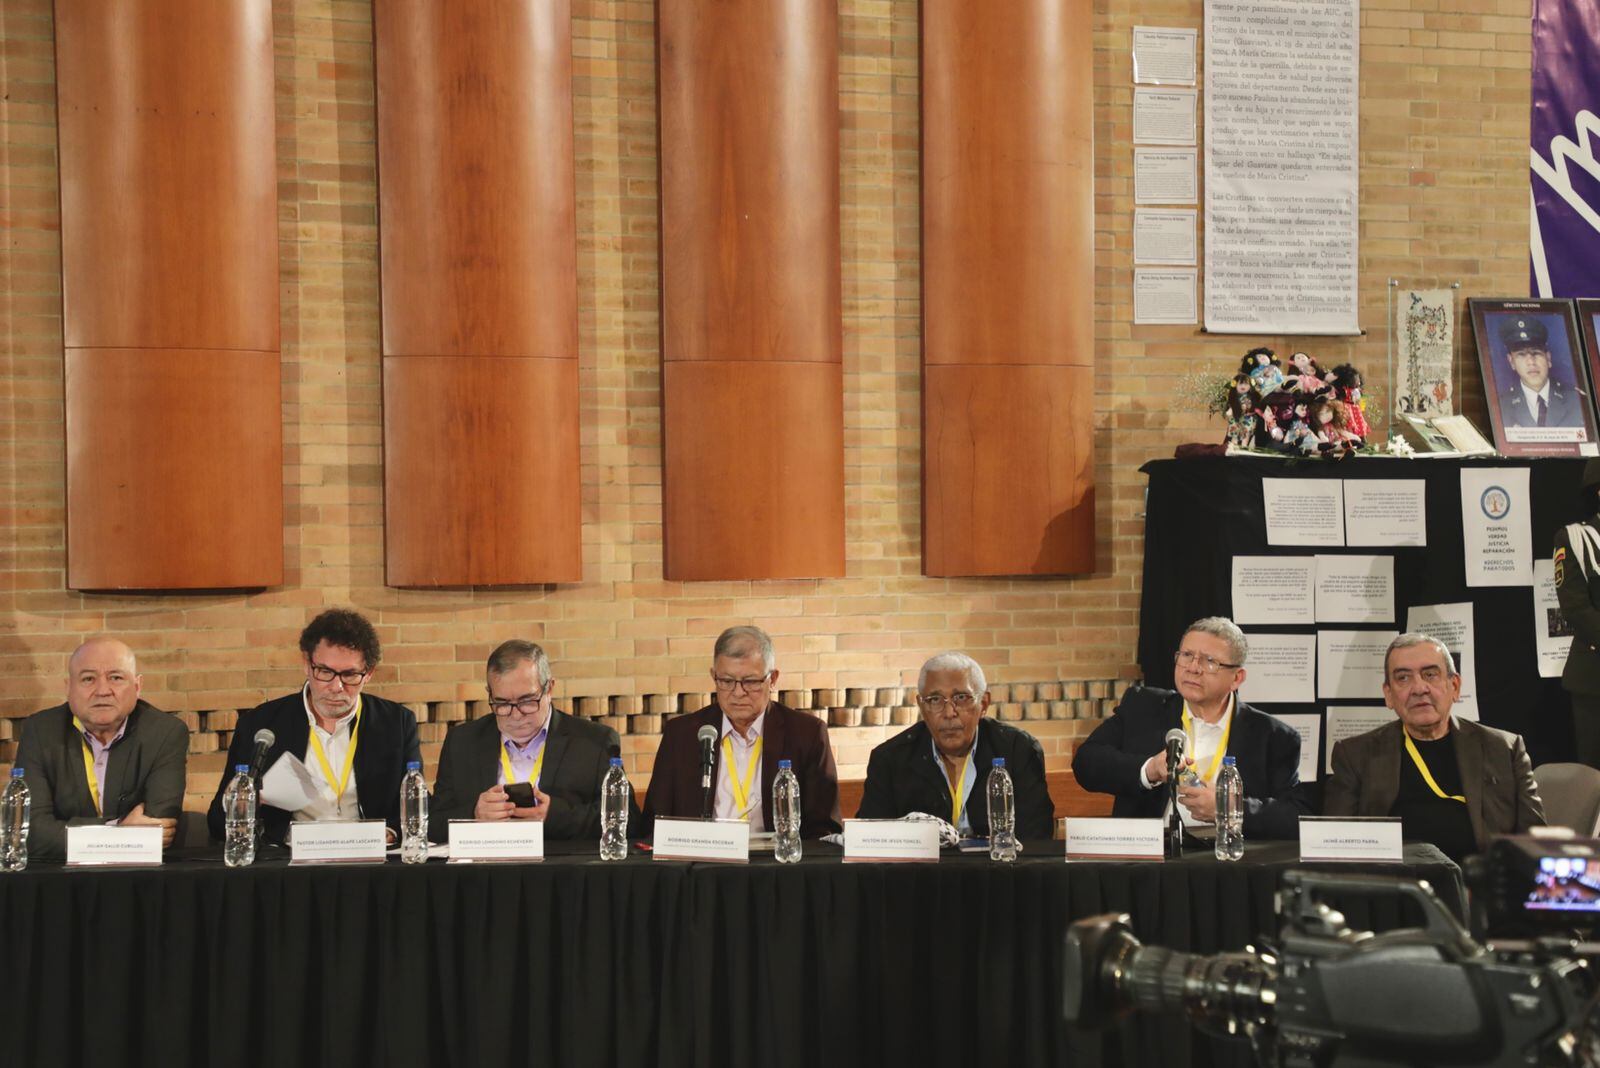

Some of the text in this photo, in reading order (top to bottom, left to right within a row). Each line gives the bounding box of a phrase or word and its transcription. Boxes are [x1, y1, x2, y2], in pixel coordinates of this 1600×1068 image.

[1247, 15, 1289, 26] complicidad
[1342, 20, 1352, 28] del
[1307, 40, 1322, 48] abril
[1325, 41, 1336, 49] del
[1339, 42, 1352, 50] año
[1261, 49, 1288, 58] Cristina
[1290, 72, 1308, 80] salud
[1302, 84, 1323, 92] Desde
[1253, 93, 1278, 102] Paulina
[1255, 105, 1268, 114] hija
[1263, 116, 1280, 124] labor
[1299, 118, 1320, 127] según
[1279, 139, 1306, 147] Cristina
[1247, 160, 1278, 168] Guaviare
[1285, 250, 1305, 259] puede
